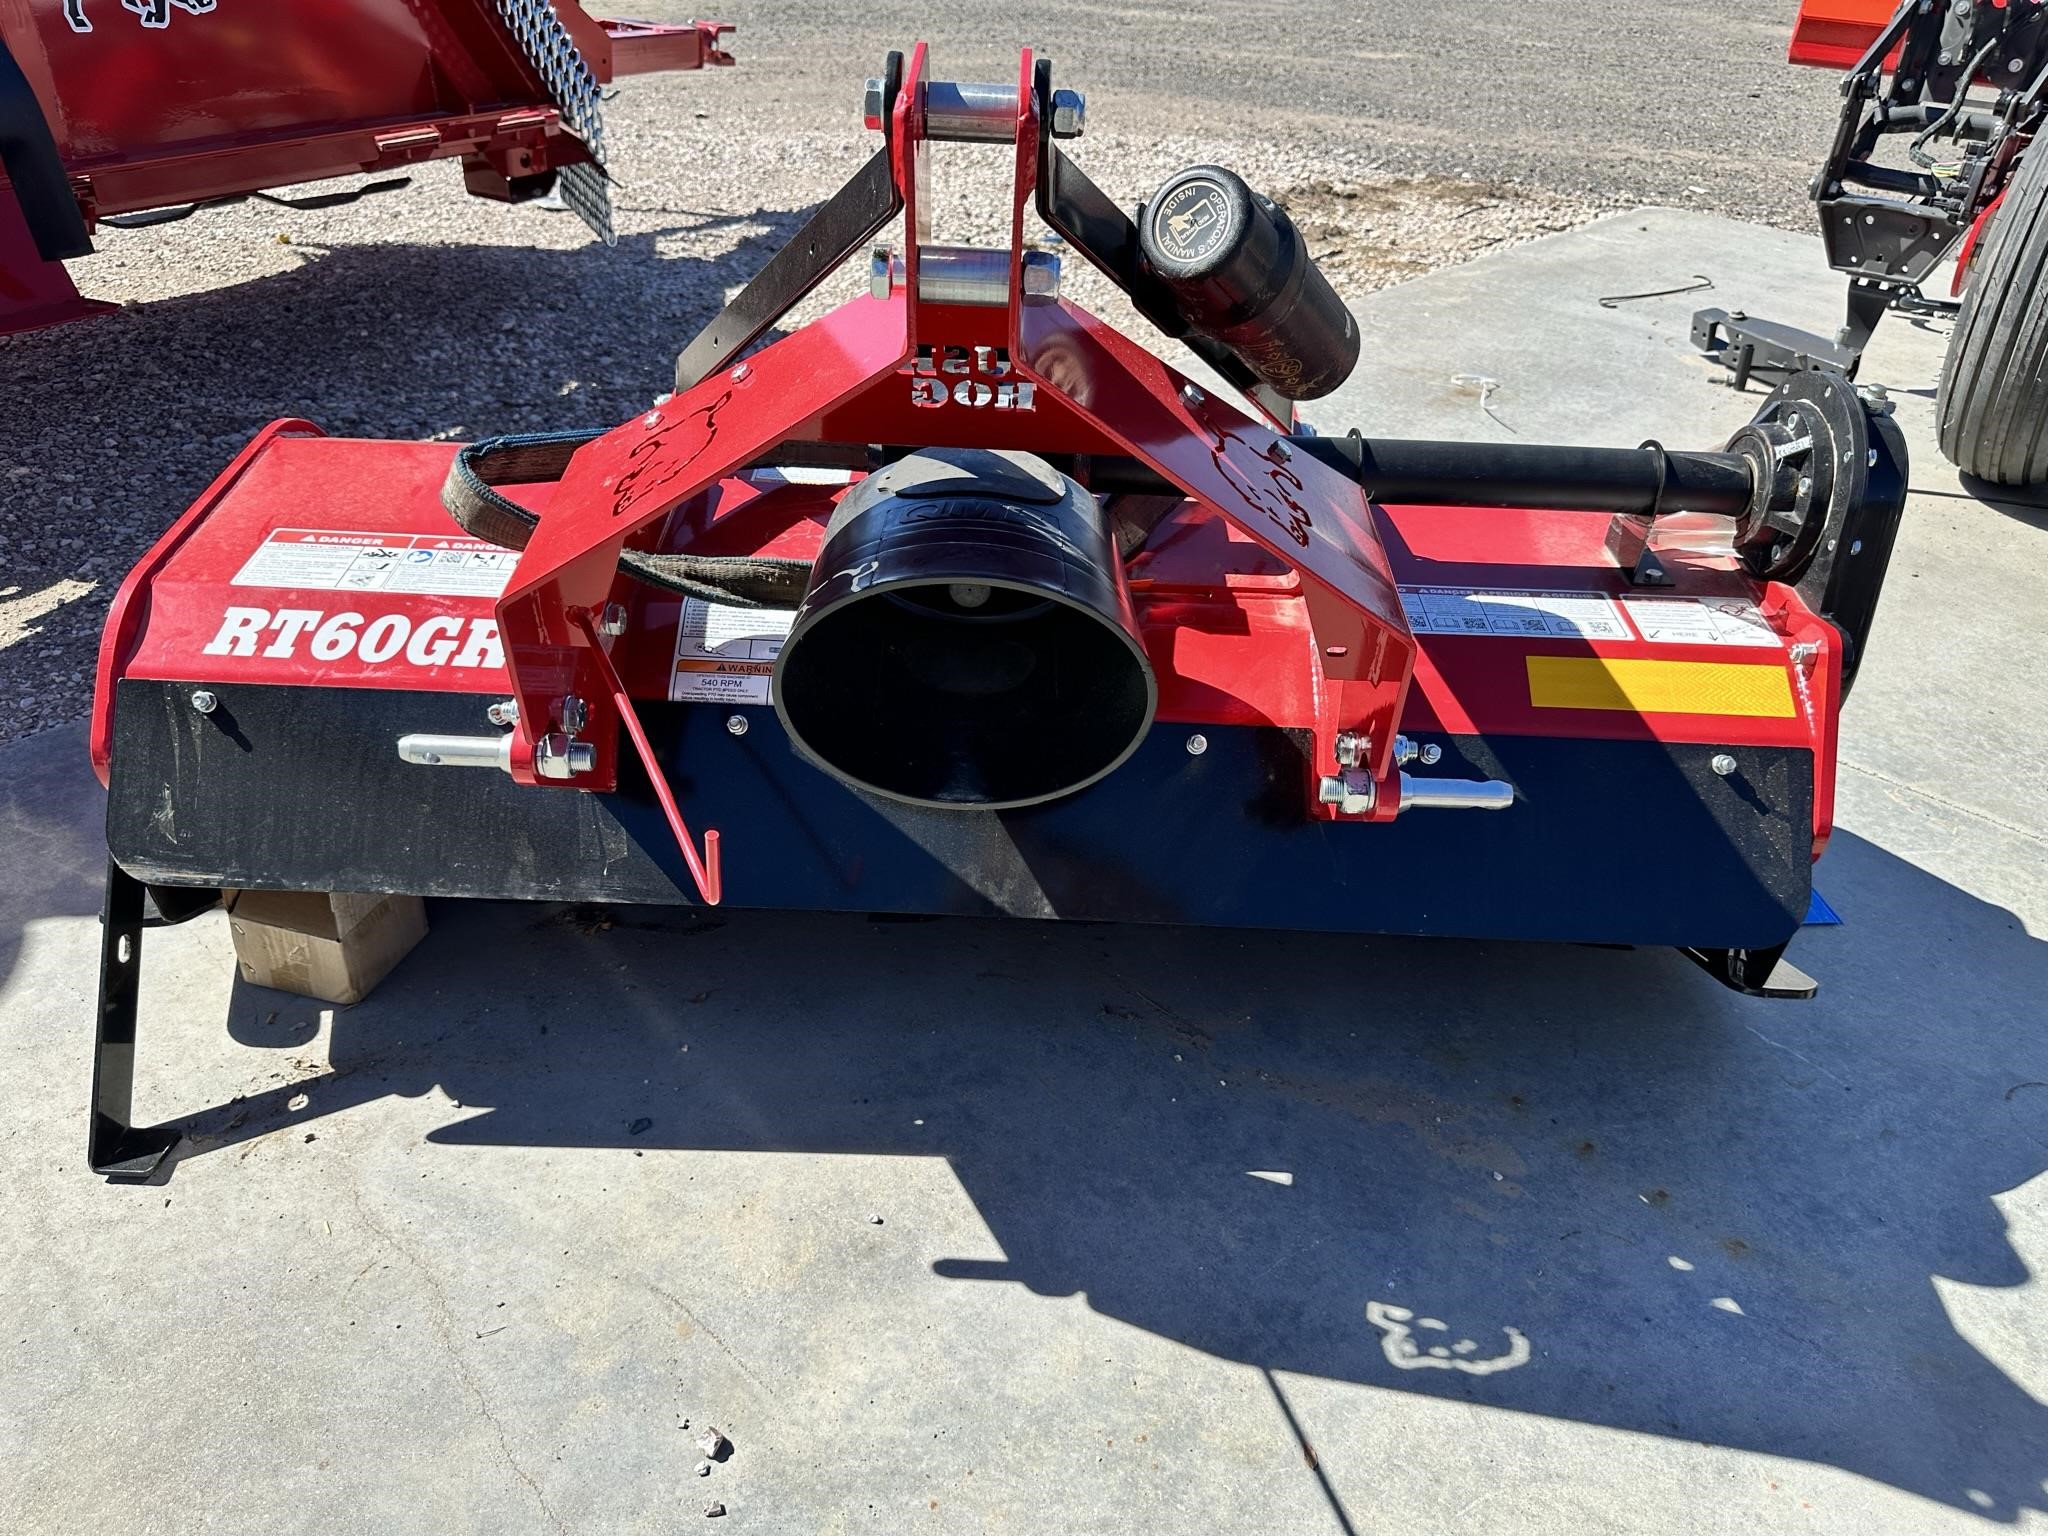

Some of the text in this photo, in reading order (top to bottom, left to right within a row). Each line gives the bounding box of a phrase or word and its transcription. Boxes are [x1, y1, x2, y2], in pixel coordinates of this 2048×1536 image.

[1164, 187, 1195, 216] INSIDE
[1162, 192, 1226, 257] OPERATOR'S MANUAL
[318, 535, 384, 546] DANGER
[1426, 588, 1474, 596] DANGER
[202, 605, 508, 669] RT60GR
[728, 664, 774, 674] WARNIN
[702, 679, 743, 687] 540 RPM
